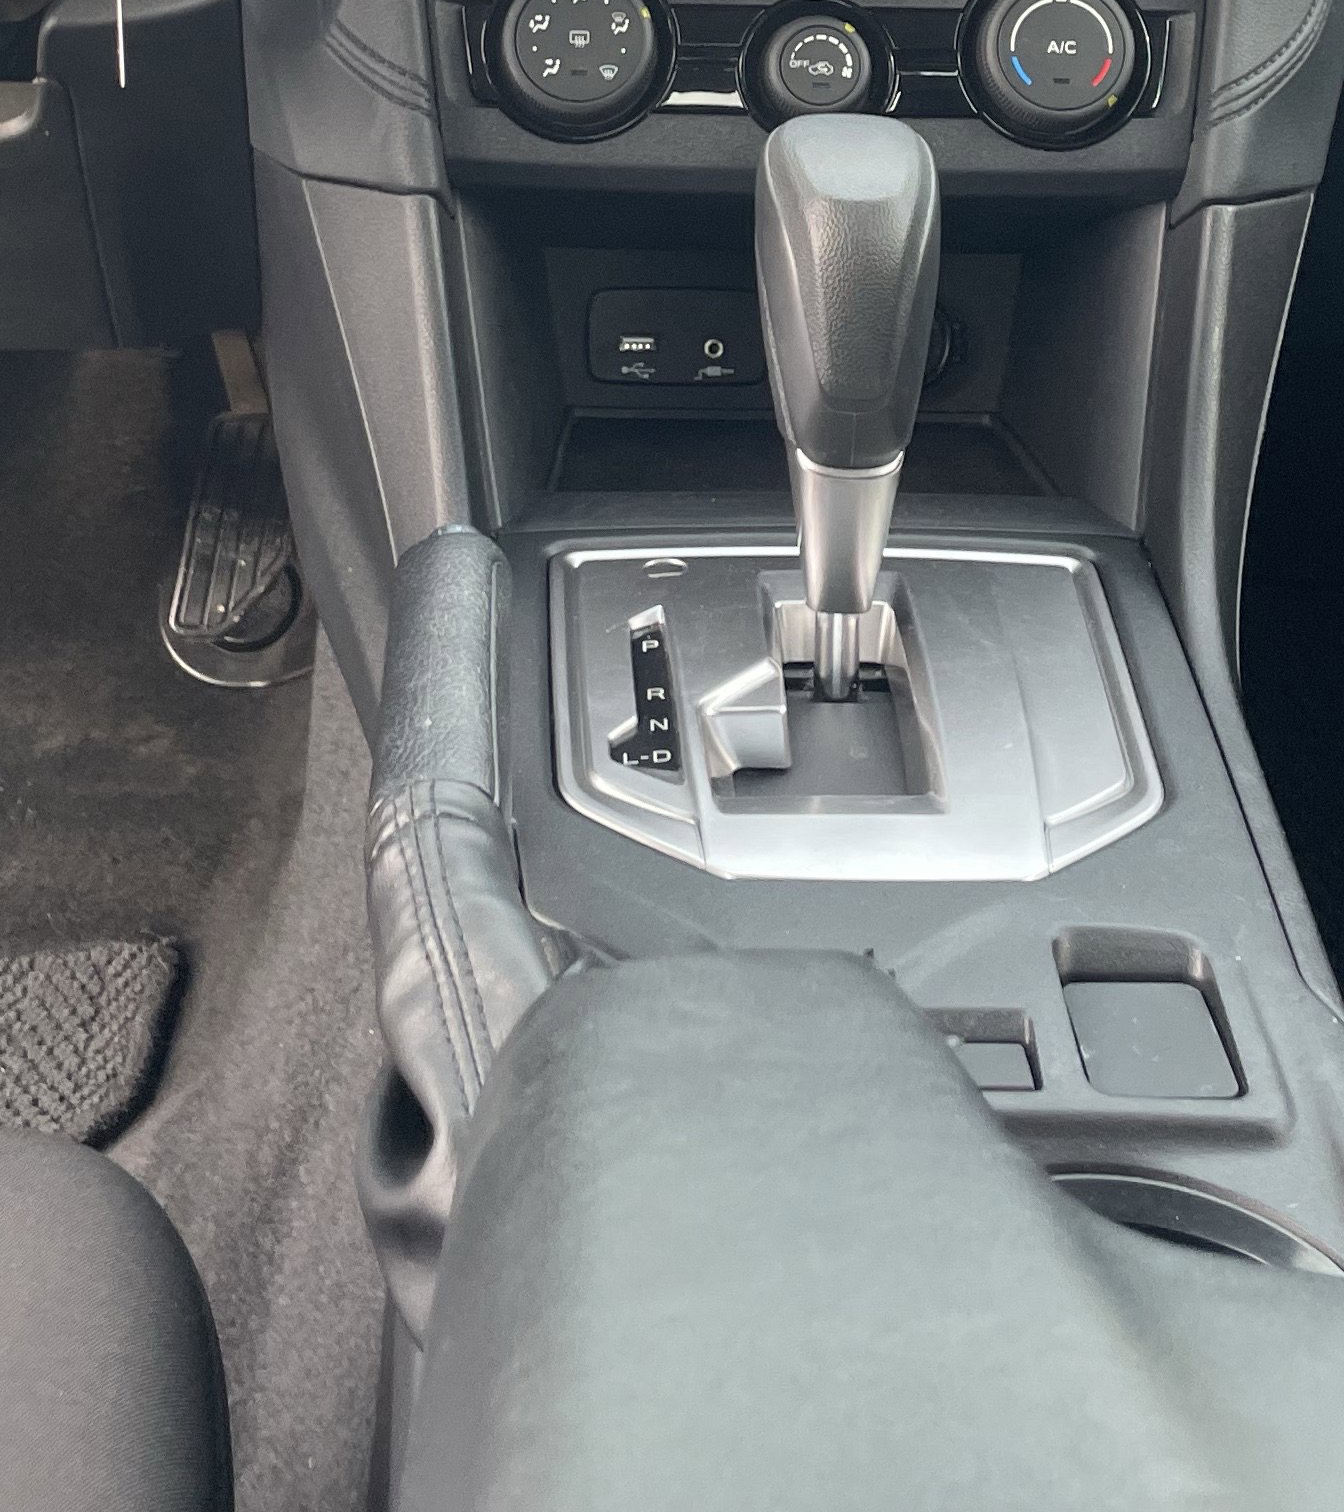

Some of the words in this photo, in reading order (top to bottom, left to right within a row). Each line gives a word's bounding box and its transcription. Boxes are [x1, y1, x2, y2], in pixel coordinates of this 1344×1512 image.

[1047, 40, 1077, 55] A/C
[789, 59, 810, 69] OFF
[641, 639, 660, 653] P
[646, 687, 666, 701] R
[649, 717, 669, 732] N
